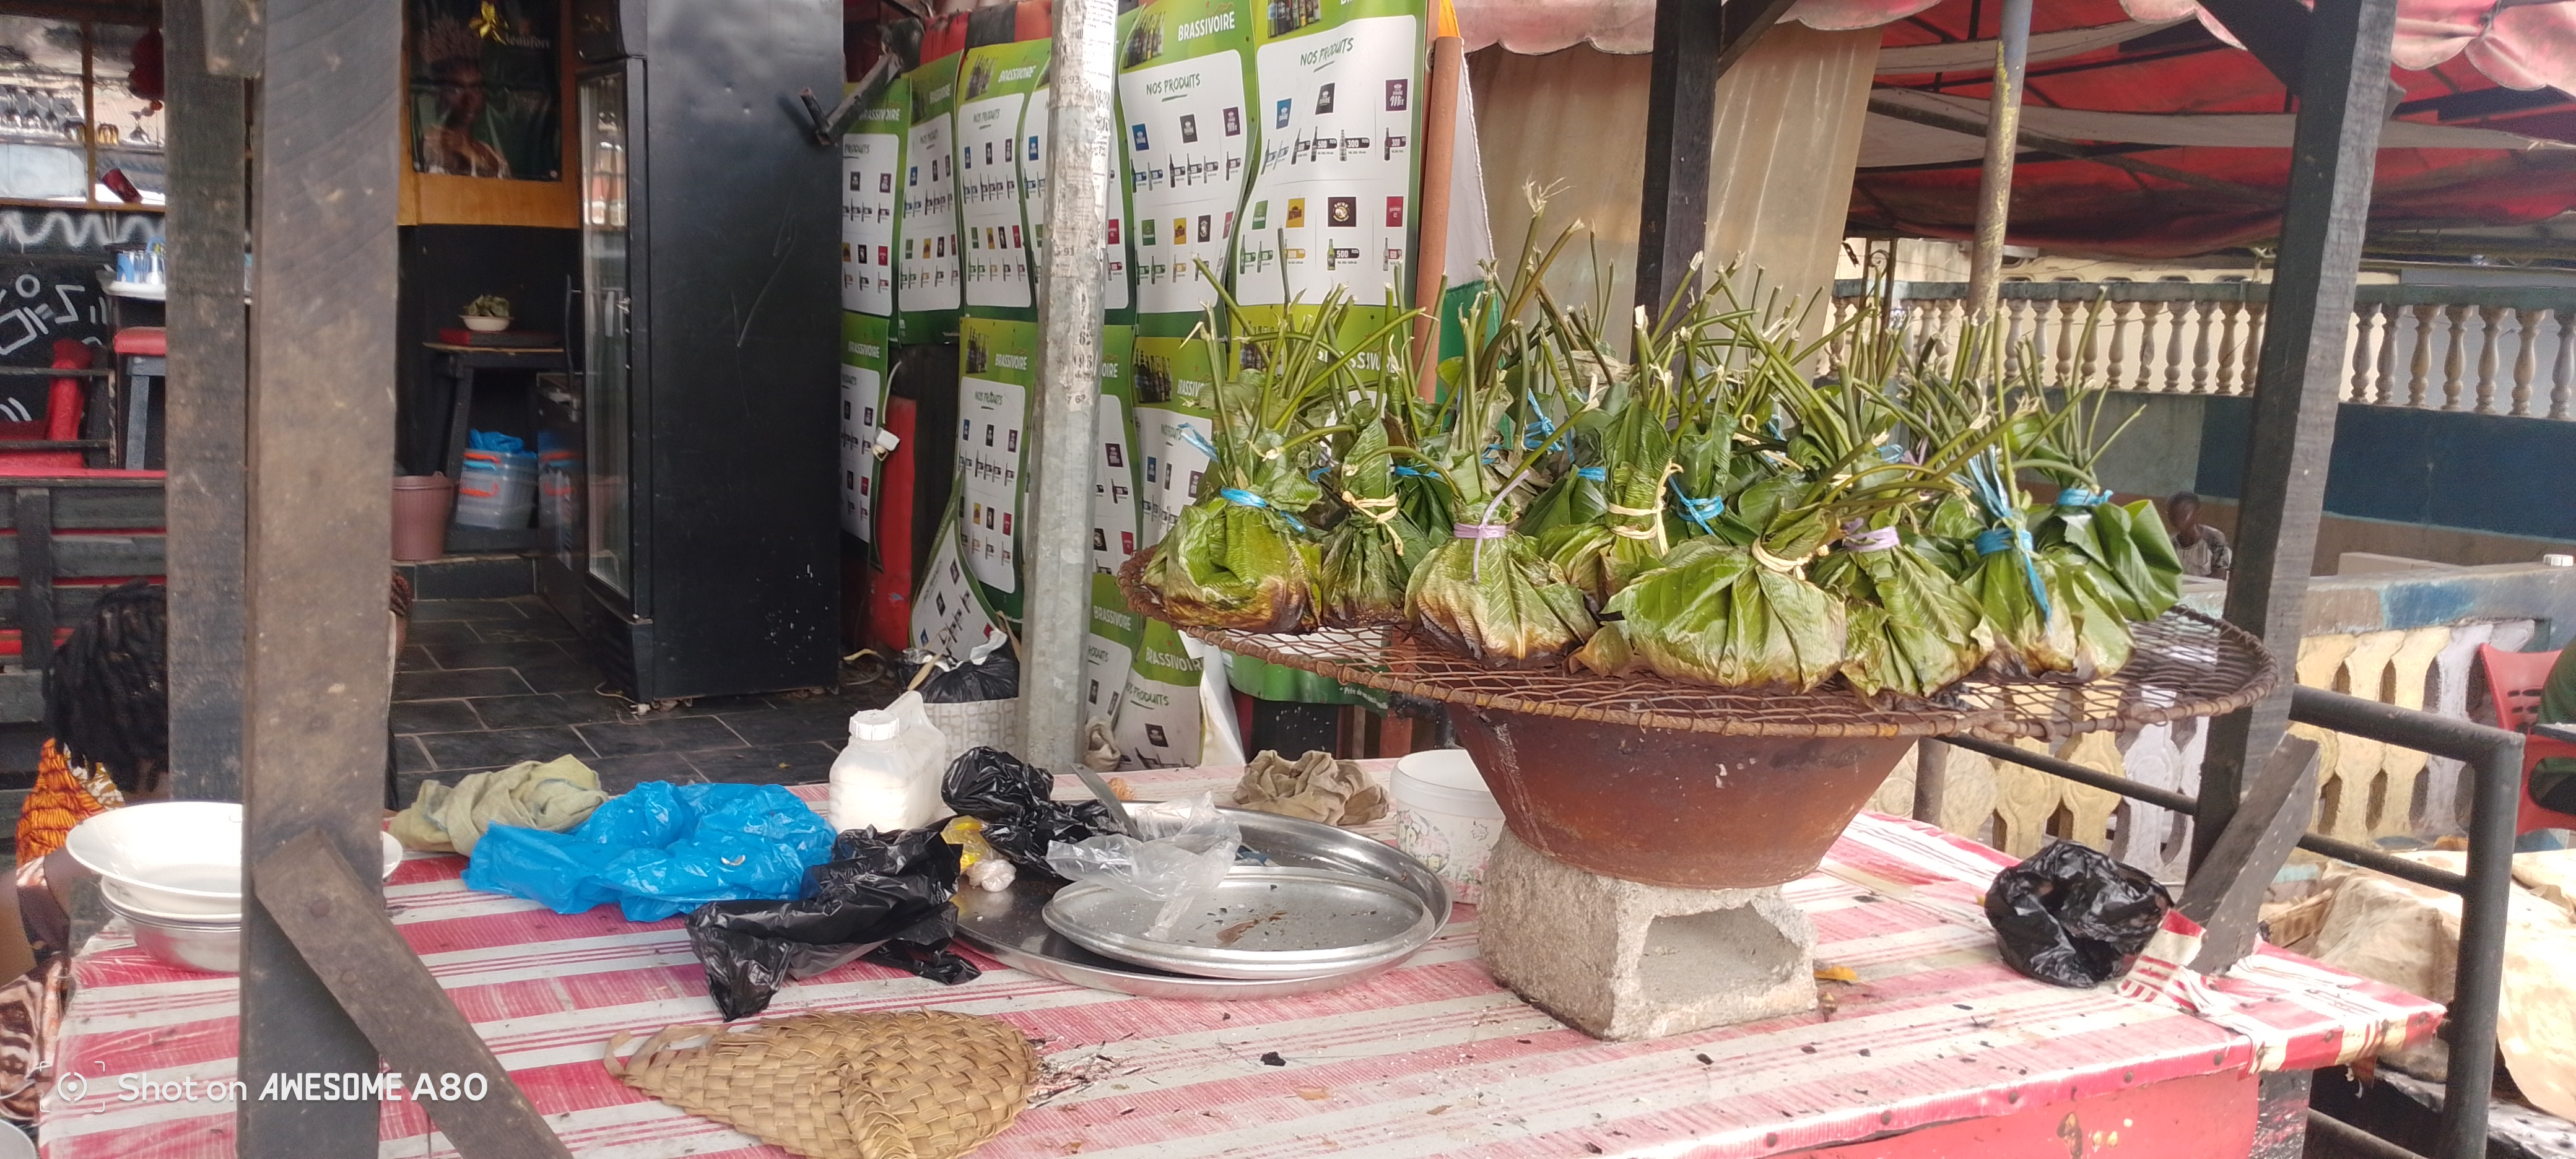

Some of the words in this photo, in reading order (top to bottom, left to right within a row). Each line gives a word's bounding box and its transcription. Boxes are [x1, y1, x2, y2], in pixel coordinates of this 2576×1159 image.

[1178, 11, 1235, 42] BRASSIVOIRE
[506, 32, 550, 49] eaufort
[1300, 49, 1318, 66] NOS
[1319, 37, 1354, 61] PRODUITS
[1146, 82, 1162, 95] NOS
[1164, 73, 1201, 93] PRODUITS
[1317, 140, 1328, 149] 500
[1347, 139, 1359, 148] 300
[1336, 250, 1349, 258] 500
[994, 353, 1028, 371] BRASSIVOIRE
[1093, 604, 1132, 632] BRASSIVOIRE
[1089, 645, 1110, 662] RODUITS
[1133, 686, 1170, 706] PRODUITS
